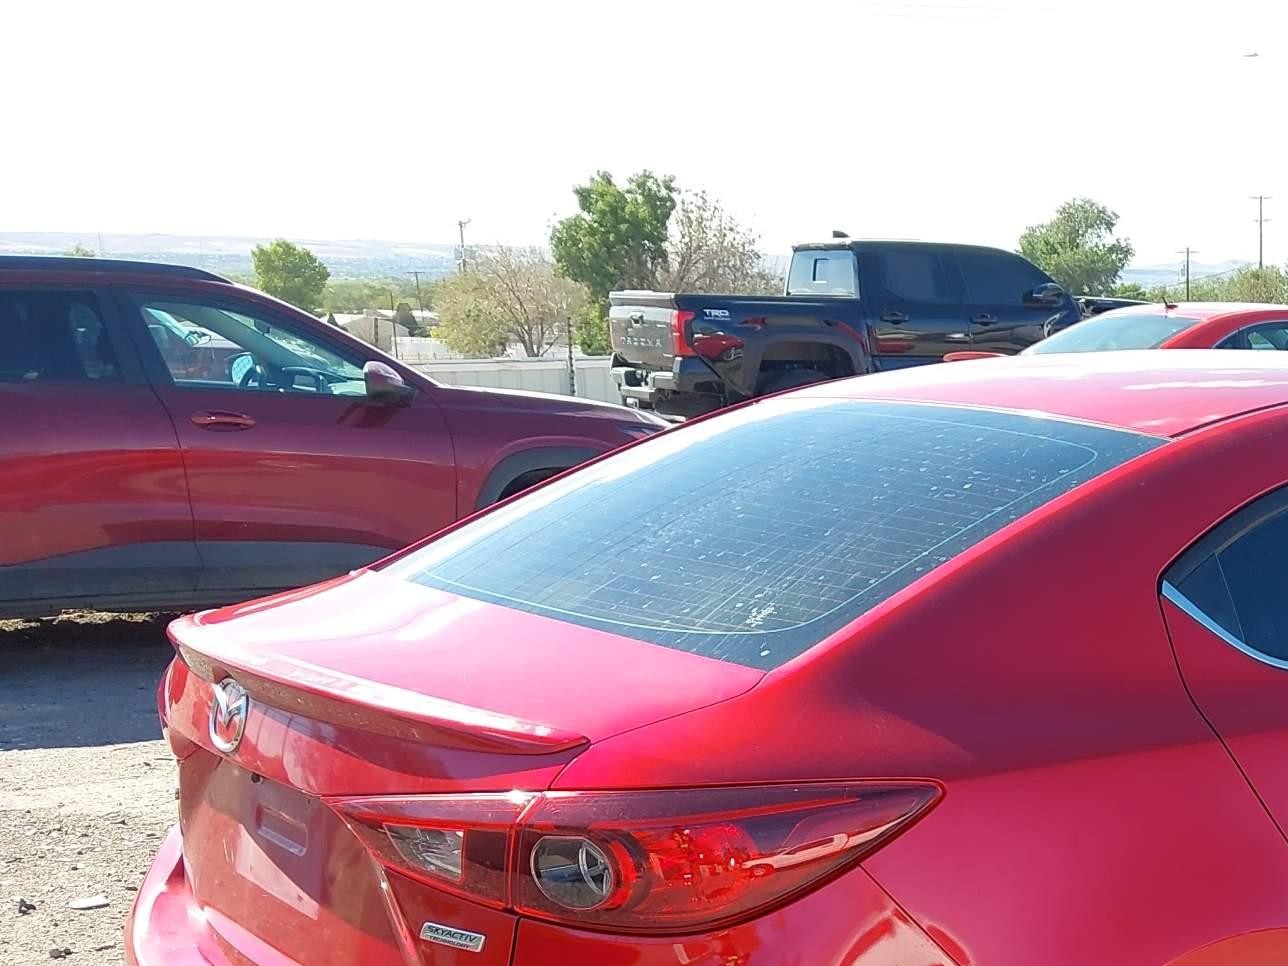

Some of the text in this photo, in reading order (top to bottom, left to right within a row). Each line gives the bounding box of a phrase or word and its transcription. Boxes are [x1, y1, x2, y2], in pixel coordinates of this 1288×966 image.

[703, 308, 730, 319] TRD
[427, 925, 477, 943] SKYACTIV
[429, 935, 470, 949] TECHNOLOGY
